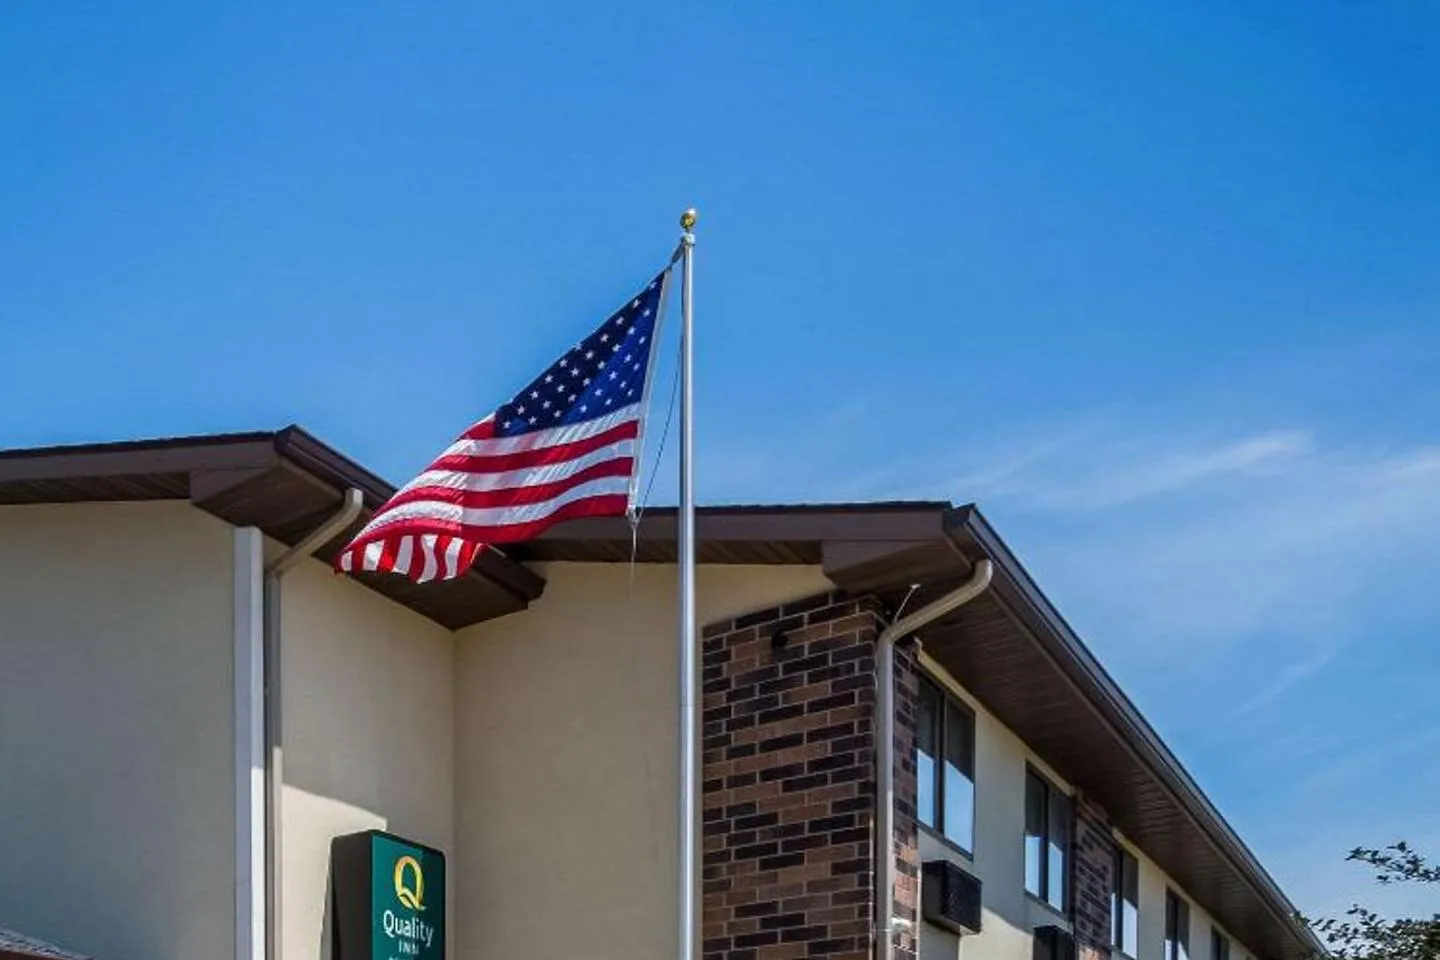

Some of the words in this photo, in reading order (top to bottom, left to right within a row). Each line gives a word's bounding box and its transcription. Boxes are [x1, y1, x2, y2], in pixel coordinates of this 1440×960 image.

[394, 855, 426, 910] Q
[383, 909, 434, 947] Quality
[398, 939, 420, 955] INN
